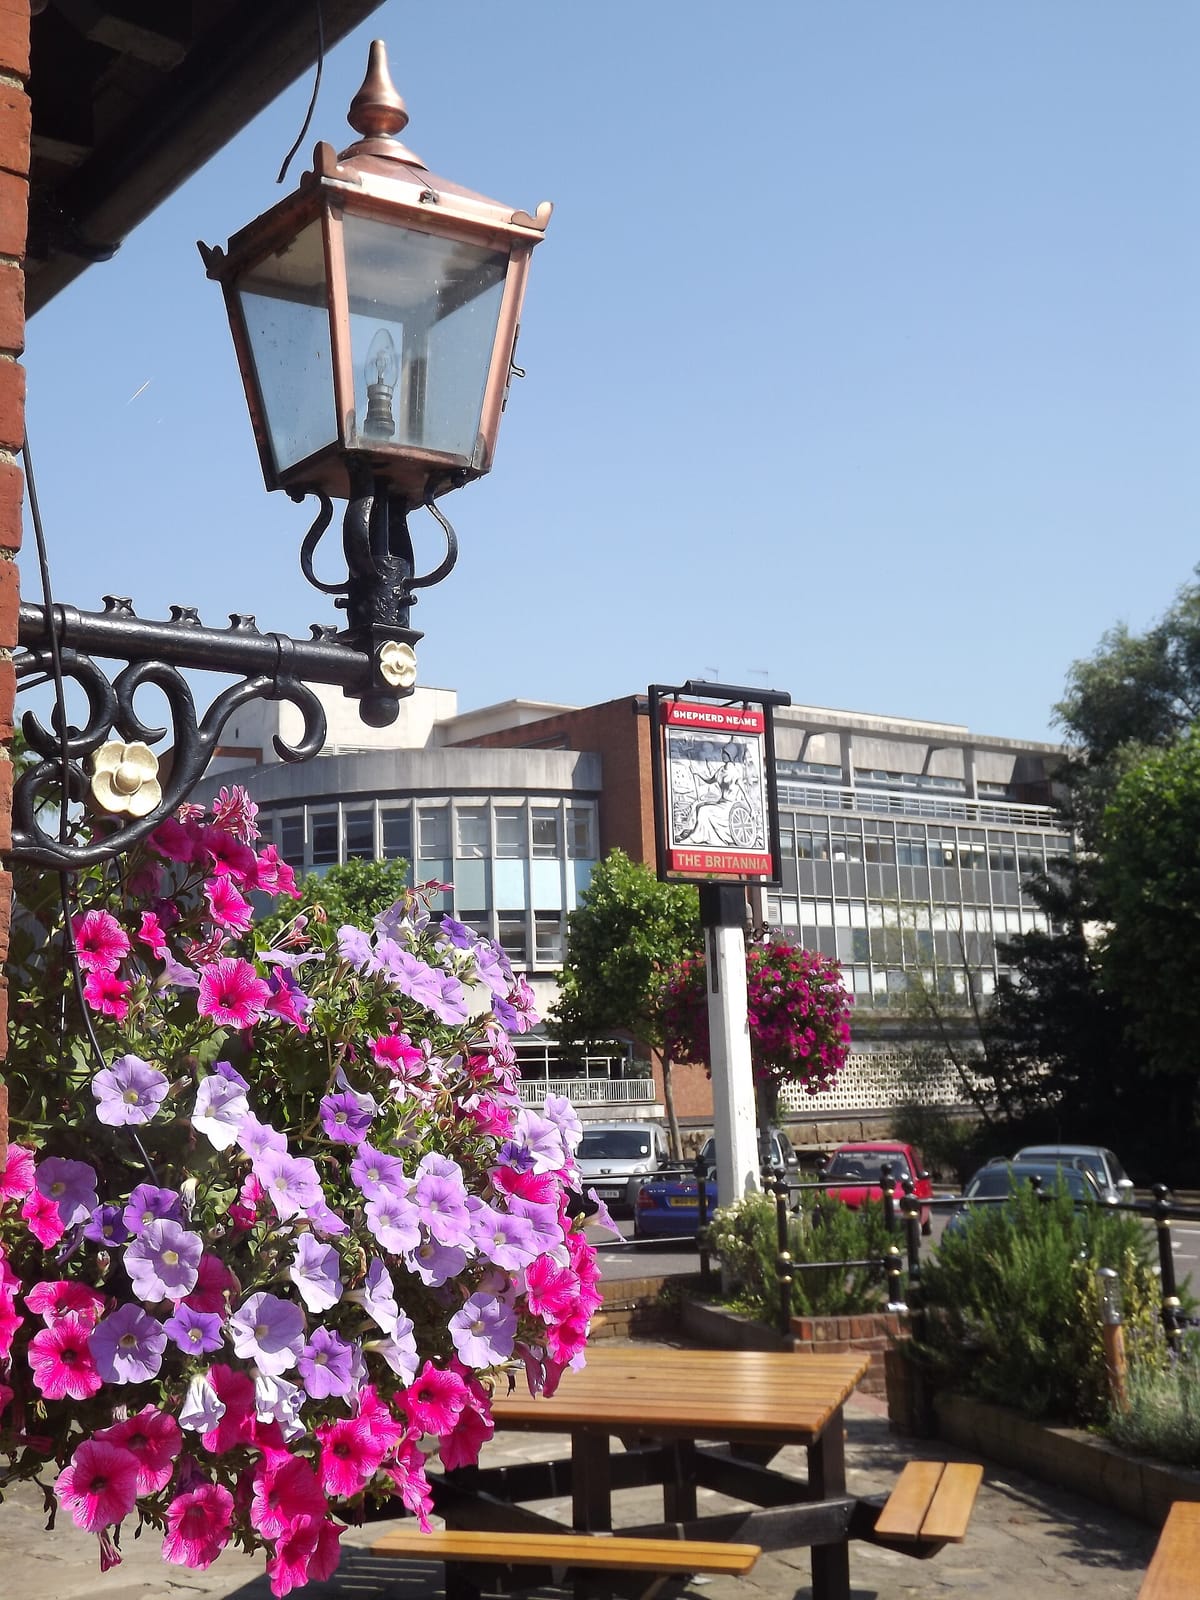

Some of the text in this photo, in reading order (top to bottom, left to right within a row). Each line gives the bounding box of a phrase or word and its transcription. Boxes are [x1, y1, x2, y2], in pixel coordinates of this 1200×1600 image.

[673, 710, 758, 726] SHEPHERD NEAME
[677, 853, 769, 870] THE BRITANNIA
